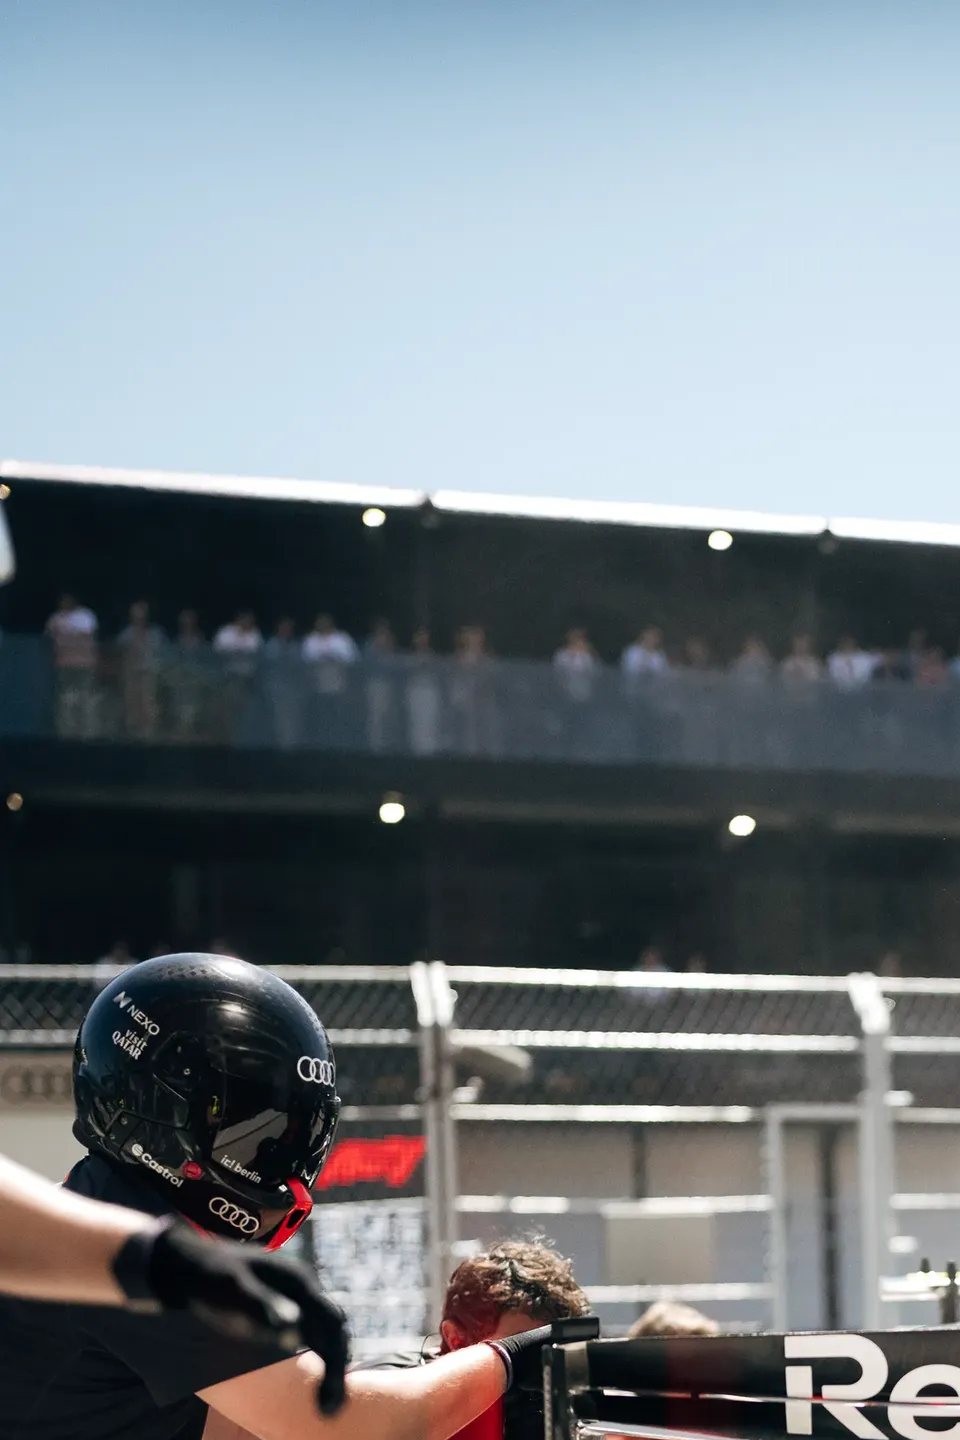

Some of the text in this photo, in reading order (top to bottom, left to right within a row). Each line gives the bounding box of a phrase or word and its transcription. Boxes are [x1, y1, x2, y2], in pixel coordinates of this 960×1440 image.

[127, 1004, 160, 1035] NEXO
[112, 1030, 141, 1060] QATAR
[125, 1029, 148, 1051] visit
[141, 1152, 184, 1188] Castrol
[233, 1165, 262, 1184] berlin
